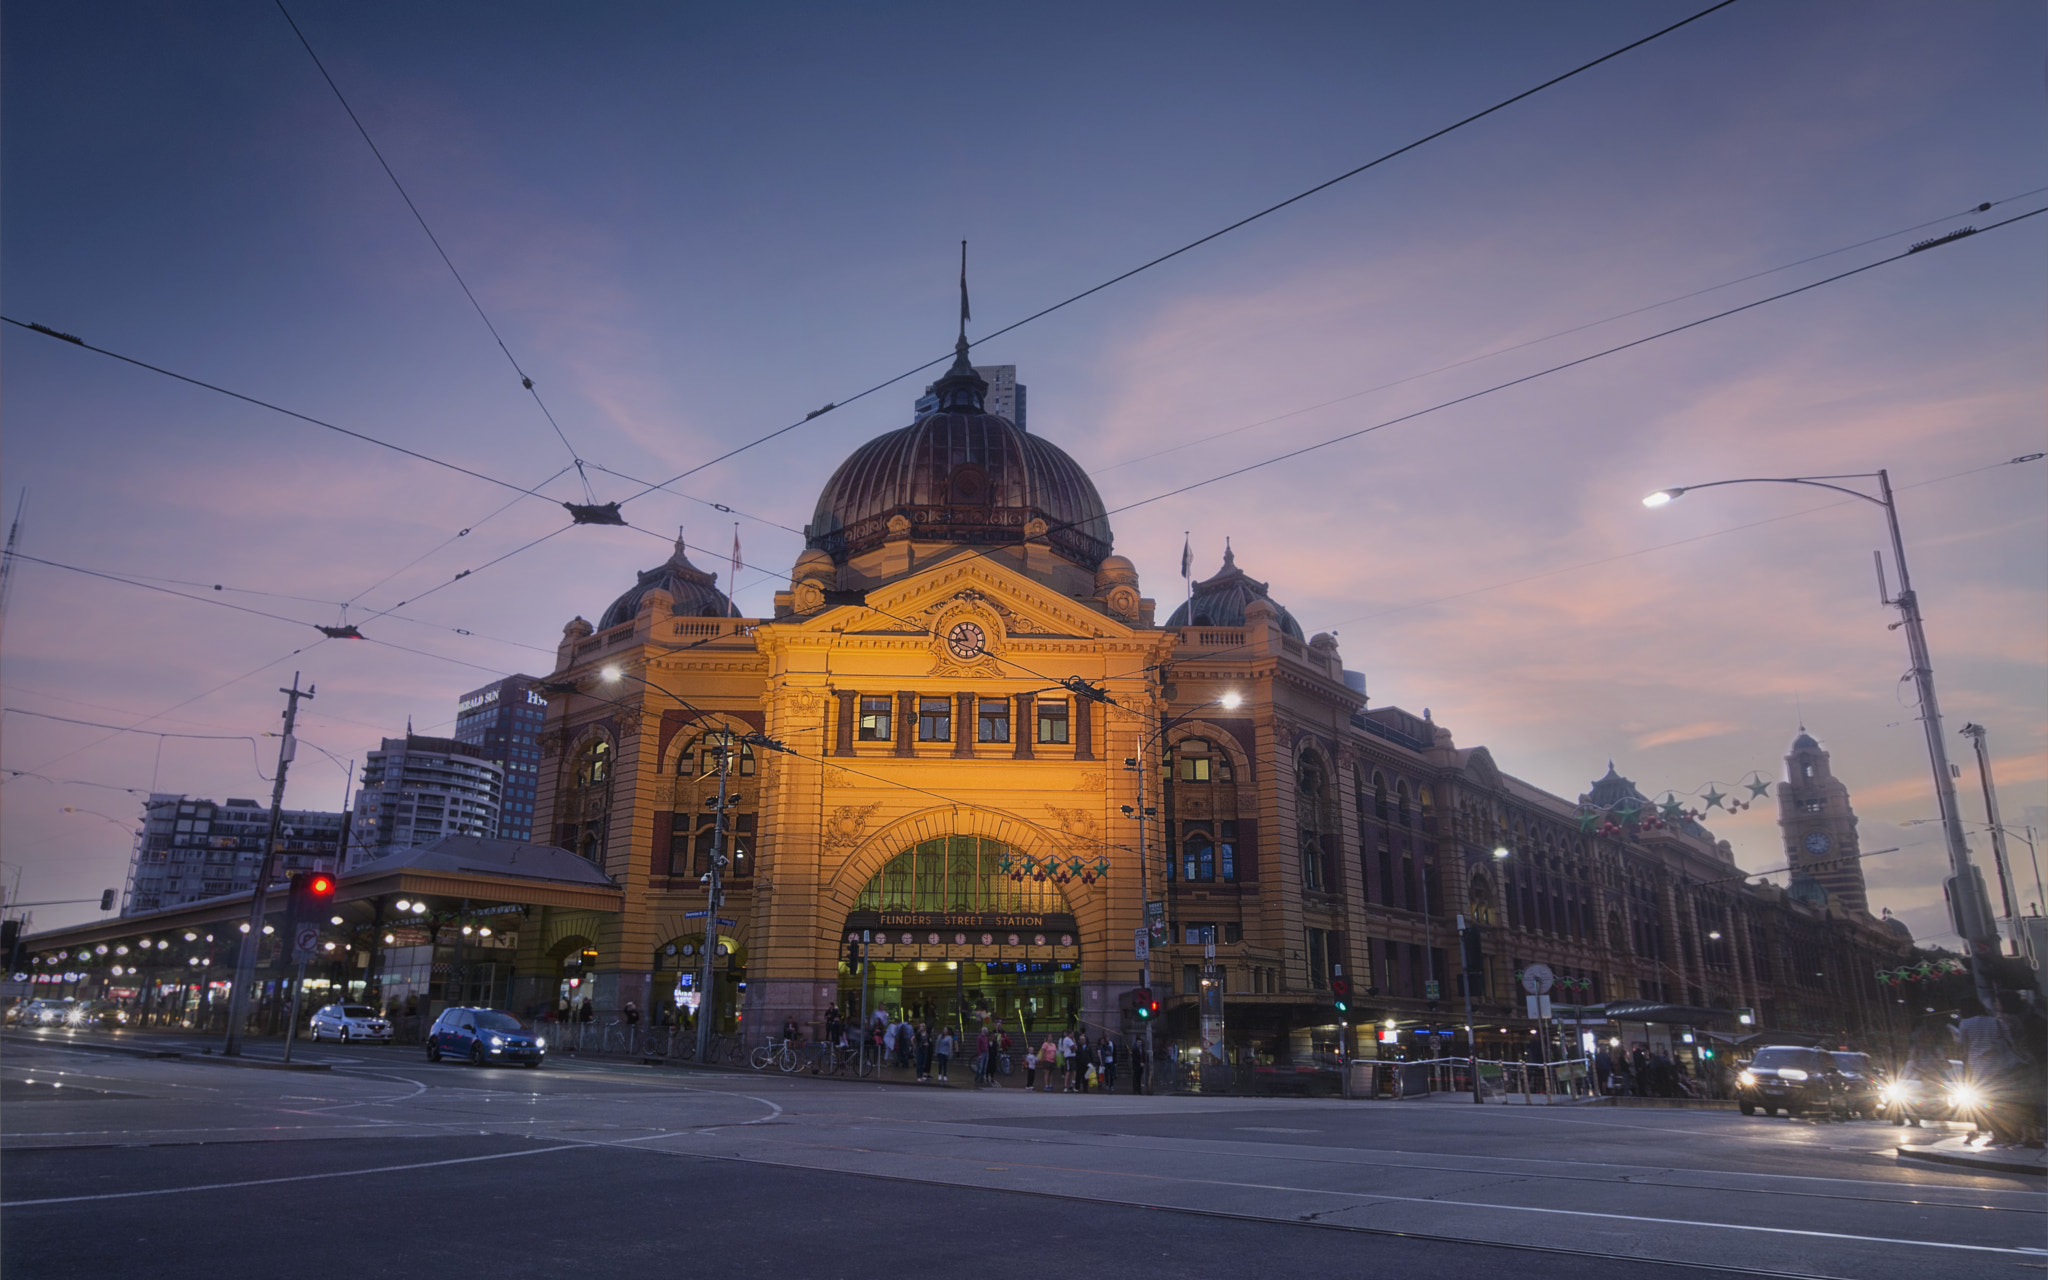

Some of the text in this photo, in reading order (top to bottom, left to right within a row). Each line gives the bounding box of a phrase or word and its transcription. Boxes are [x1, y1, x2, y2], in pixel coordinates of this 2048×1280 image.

[880, 915, 1043, 926] FLINDERS STREET STATION
